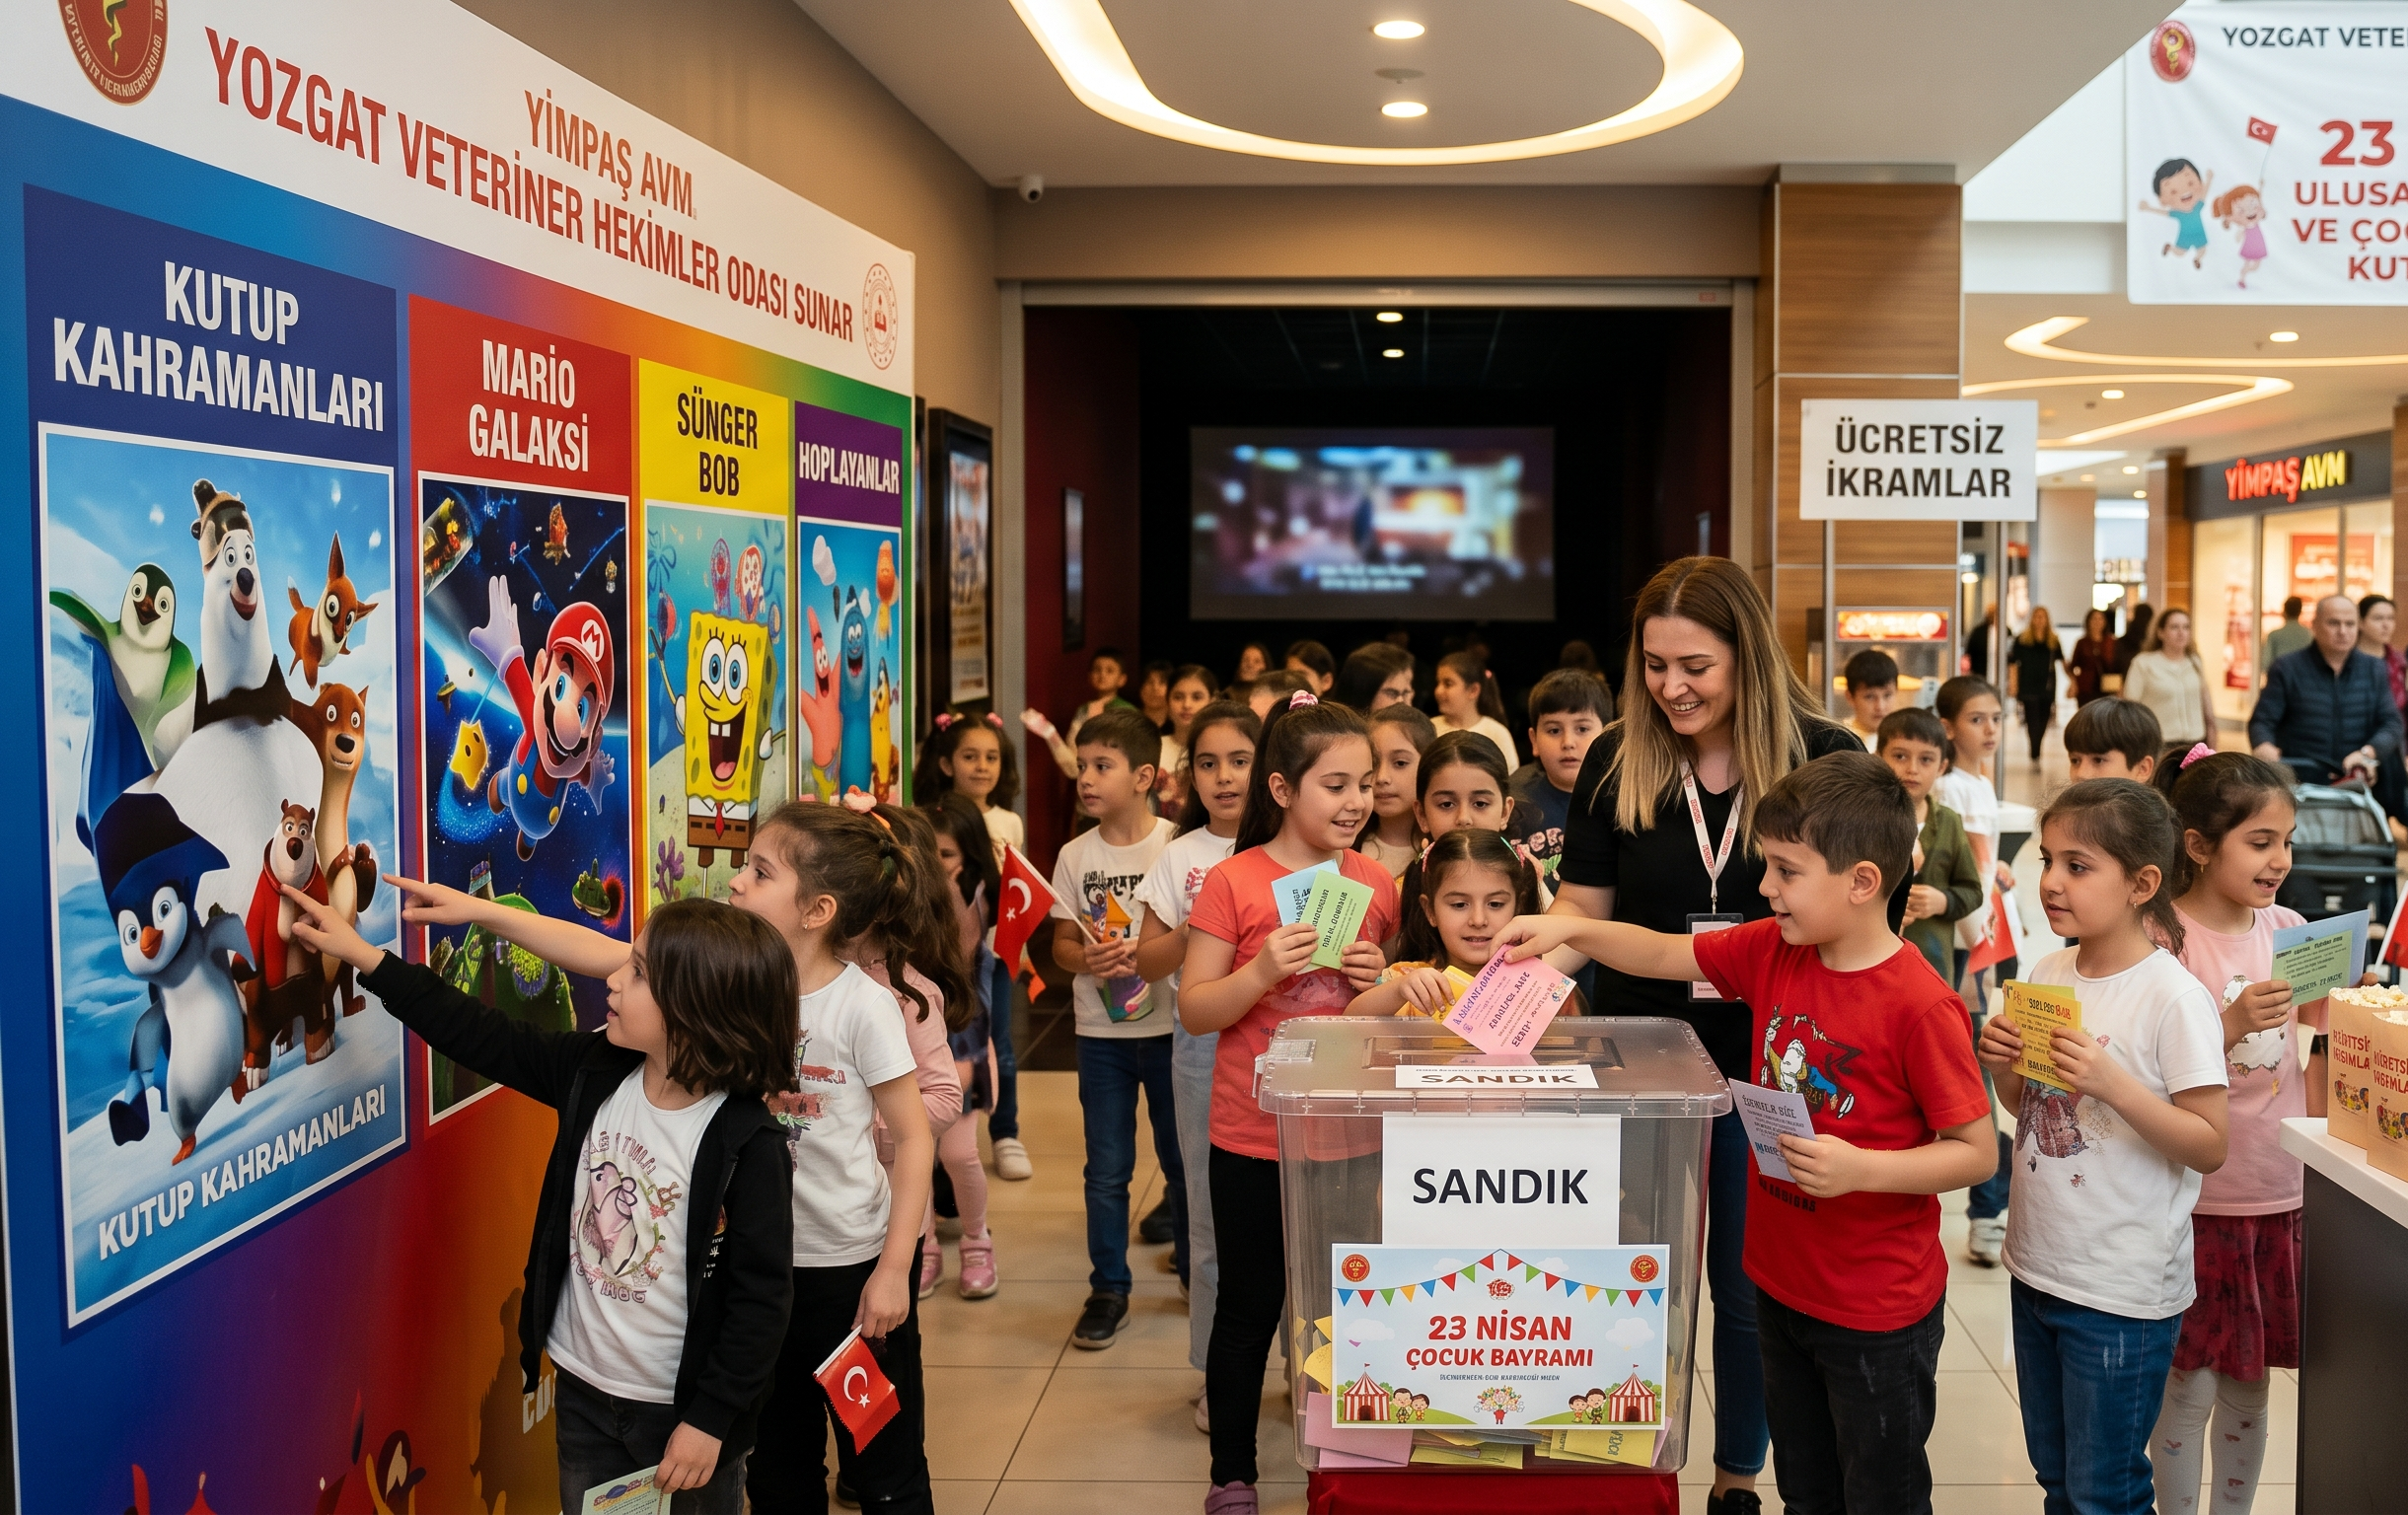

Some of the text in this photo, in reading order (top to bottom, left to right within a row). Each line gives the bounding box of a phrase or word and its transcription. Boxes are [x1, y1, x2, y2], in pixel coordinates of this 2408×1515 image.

[2223, 28, 2408, 46] YOZGAT VETE
[525, 88, 632, 200] YİMPAŞ
[2319, 120, 2394, 166] 23
[204, 26, 387, 166] YOZGAT
[398, 111, 584, 244] VETERİNER
[594, 198, 720, 295] HEKİMLER
[727, 255, 788, 320] ODASI
[794, 283, 853, 342] SUNAR
[2292, 219, 2408, 251] VE ÇO
[165, 260, 299, 345] KUTUP
[54, 317, 384, 432] KAHRAMANLARI
[482, 339, 575, 408] MARİO
[470, 403, 589, 472] GALAKSİ
[678, 386, 759, 450] SÜNGER
[1835, 416, 2005, 454] ÜCRETSİZ
[699, 451, 740, 496] BOB
[799, 441, 900, 495] HOPLAYANLAR
[1827, 460, 2010, 497] İKRAMLAR
[2226, 450, 2346, 503] YİMPAŞ AVM
[1421, 1074, 1578, 1084] SANDIK
[99, 1083, 386, 1262] KUTUP KAHRAMANLARI
[1412, 1168, 1589, 1205] SANDIK
[1427, 1309, 1572, 1340] 23 NİSAN
[1406, 1348, 1594, 1371] ÇOCUK BAYRAMI
